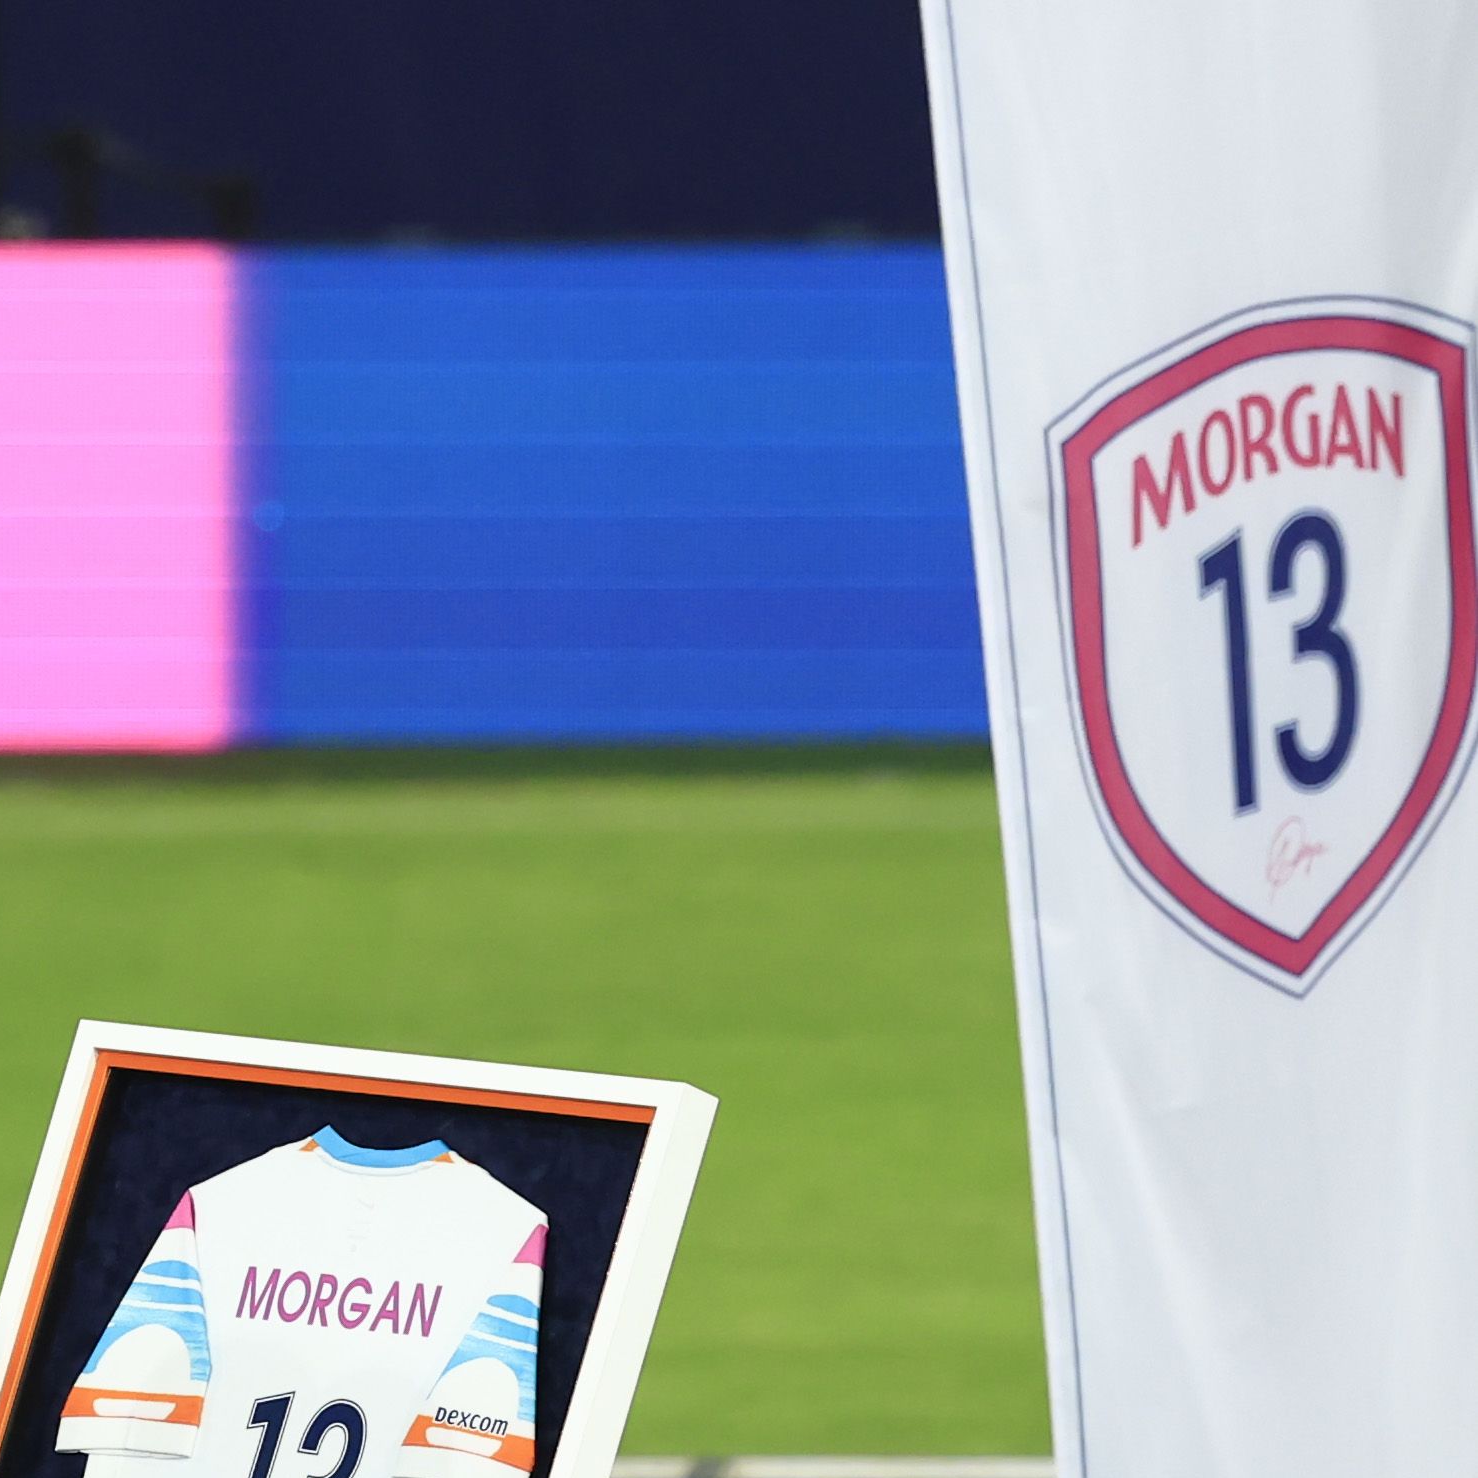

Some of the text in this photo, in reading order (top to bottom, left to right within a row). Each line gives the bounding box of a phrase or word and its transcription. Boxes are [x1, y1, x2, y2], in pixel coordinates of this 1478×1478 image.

[1131, 383, 1406, 550] MORGAN
[1197, 506, 1362, 818] 13
[235, 1265, 443, 1338] MORGAN
